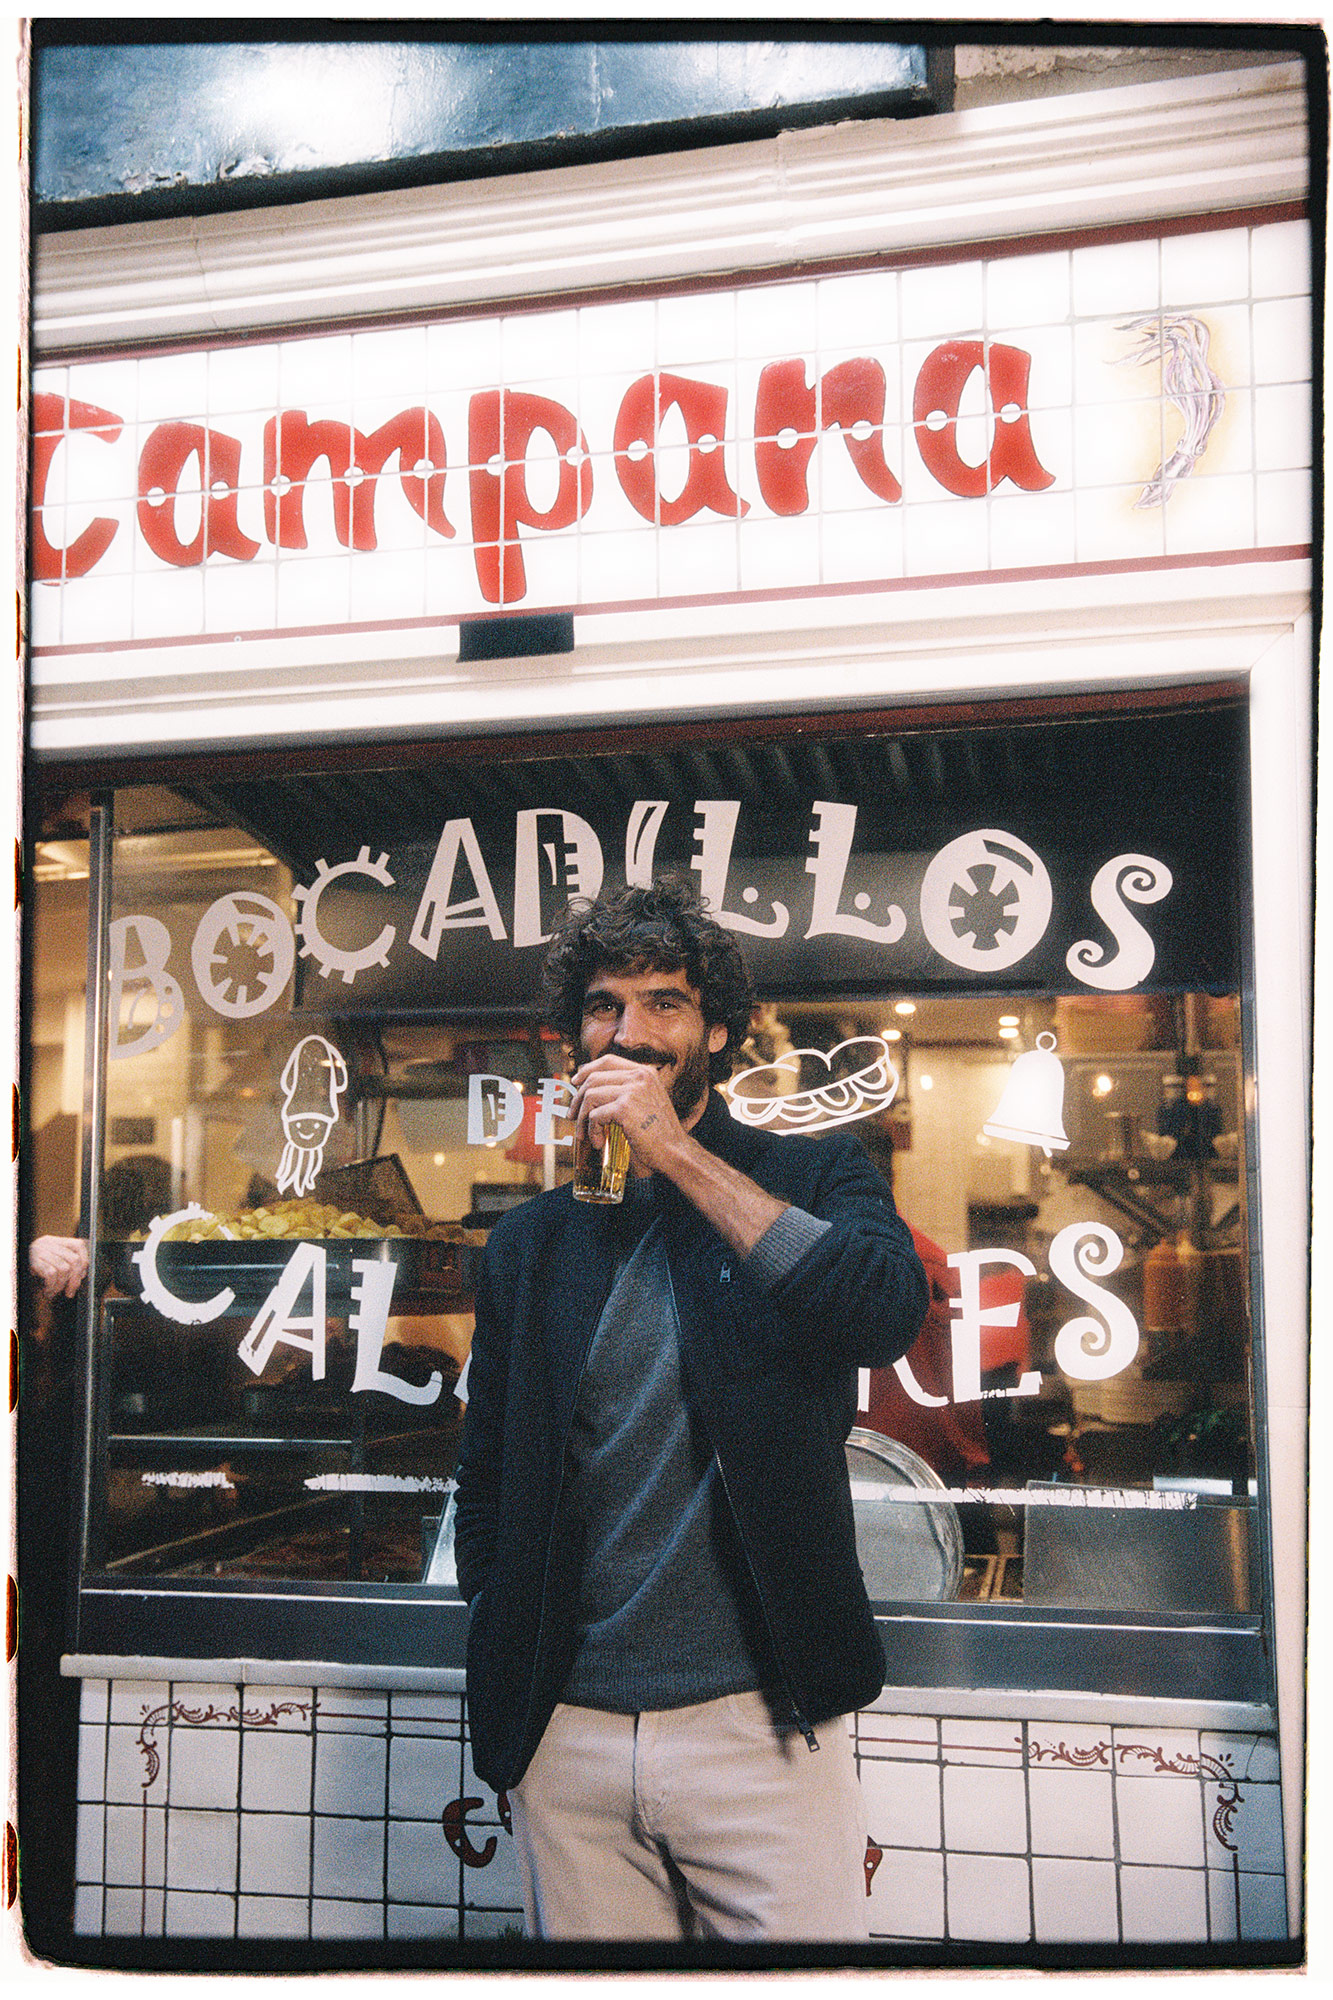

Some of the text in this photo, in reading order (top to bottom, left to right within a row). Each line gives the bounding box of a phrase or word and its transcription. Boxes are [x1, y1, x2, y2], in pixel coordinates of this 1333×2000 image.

[31, 339, 1056, 604] Campana
[108, 800, 1173, 1060] BOCADILLOS
[467, 1074, 578, 1147] DE
[132, 1202, 1139, 1412] CALES
